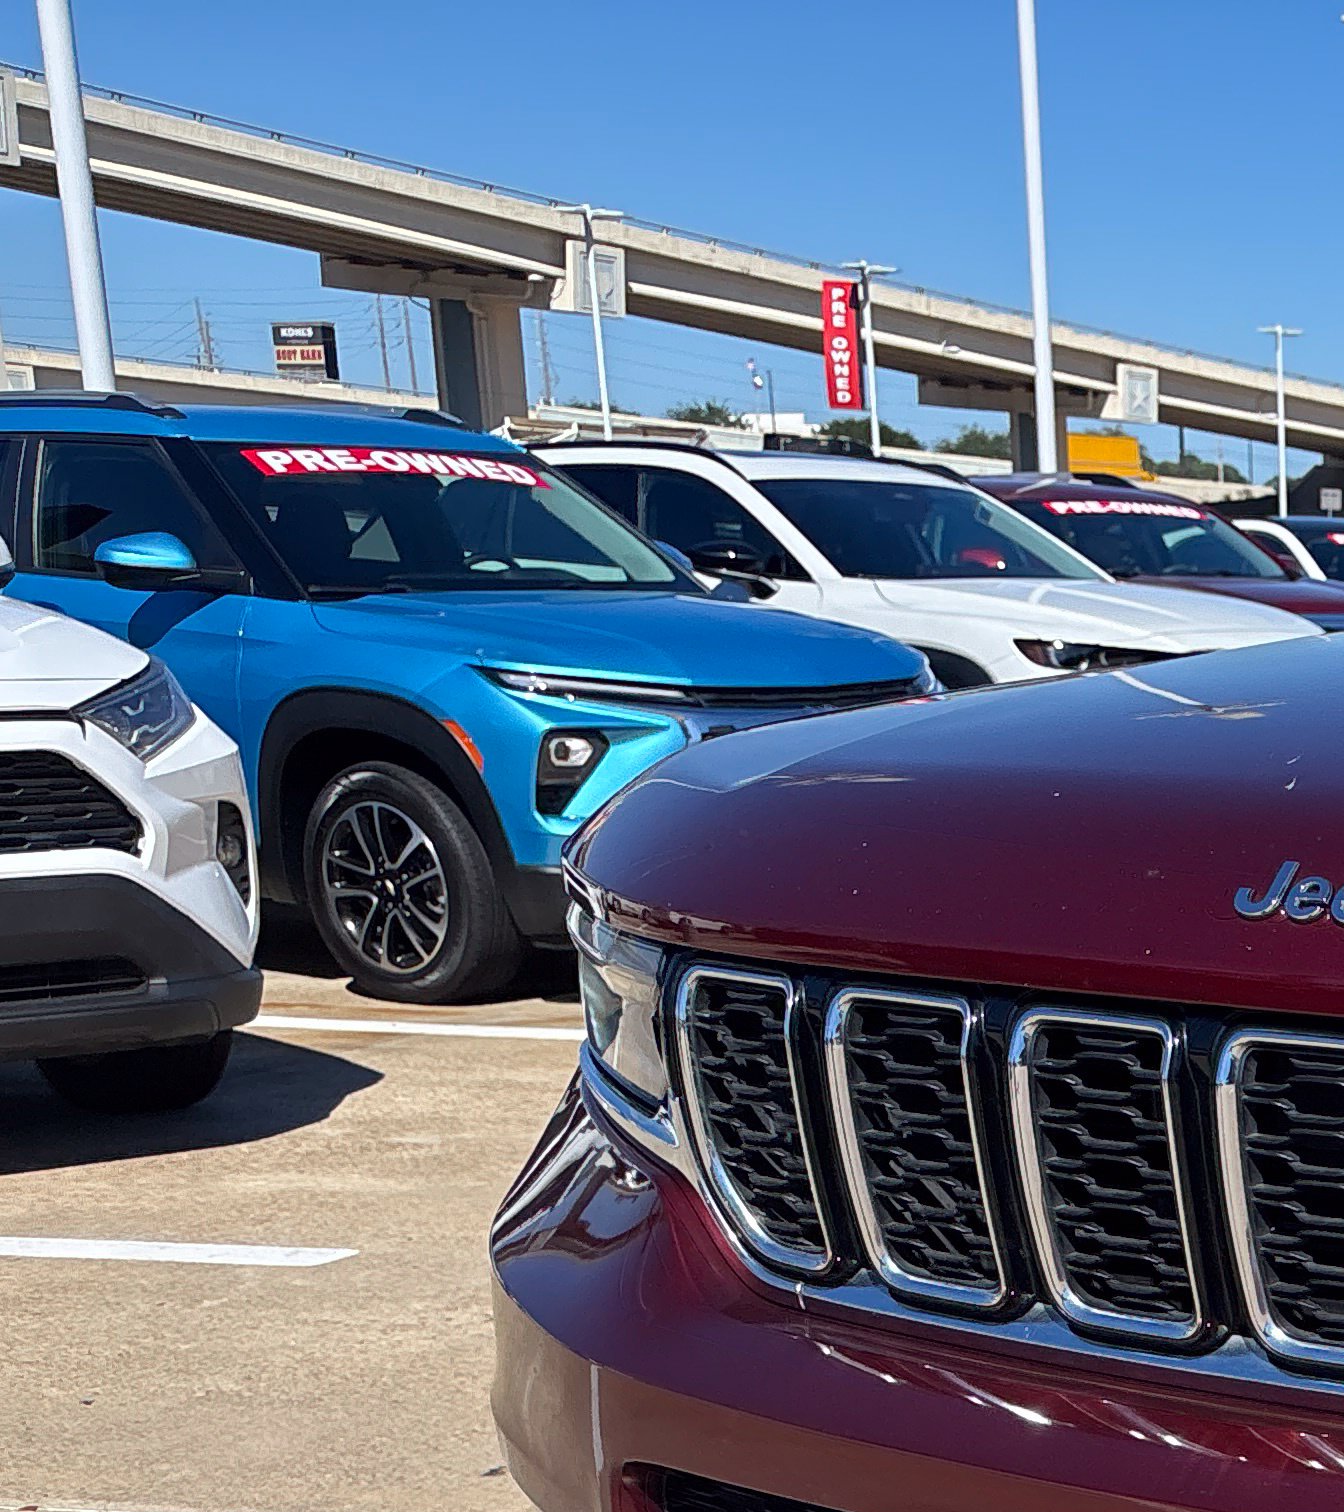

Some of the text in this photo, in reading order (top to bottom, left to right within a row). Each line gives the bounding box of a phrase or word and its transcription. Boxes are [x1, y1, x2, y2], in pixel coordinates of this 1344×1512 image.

[831, 287, 851, 403] PRE OWNED
[257, 450, 537, 486] PRE-OWNED
[1050, 500, 1202, 520] PRE-OWNED
